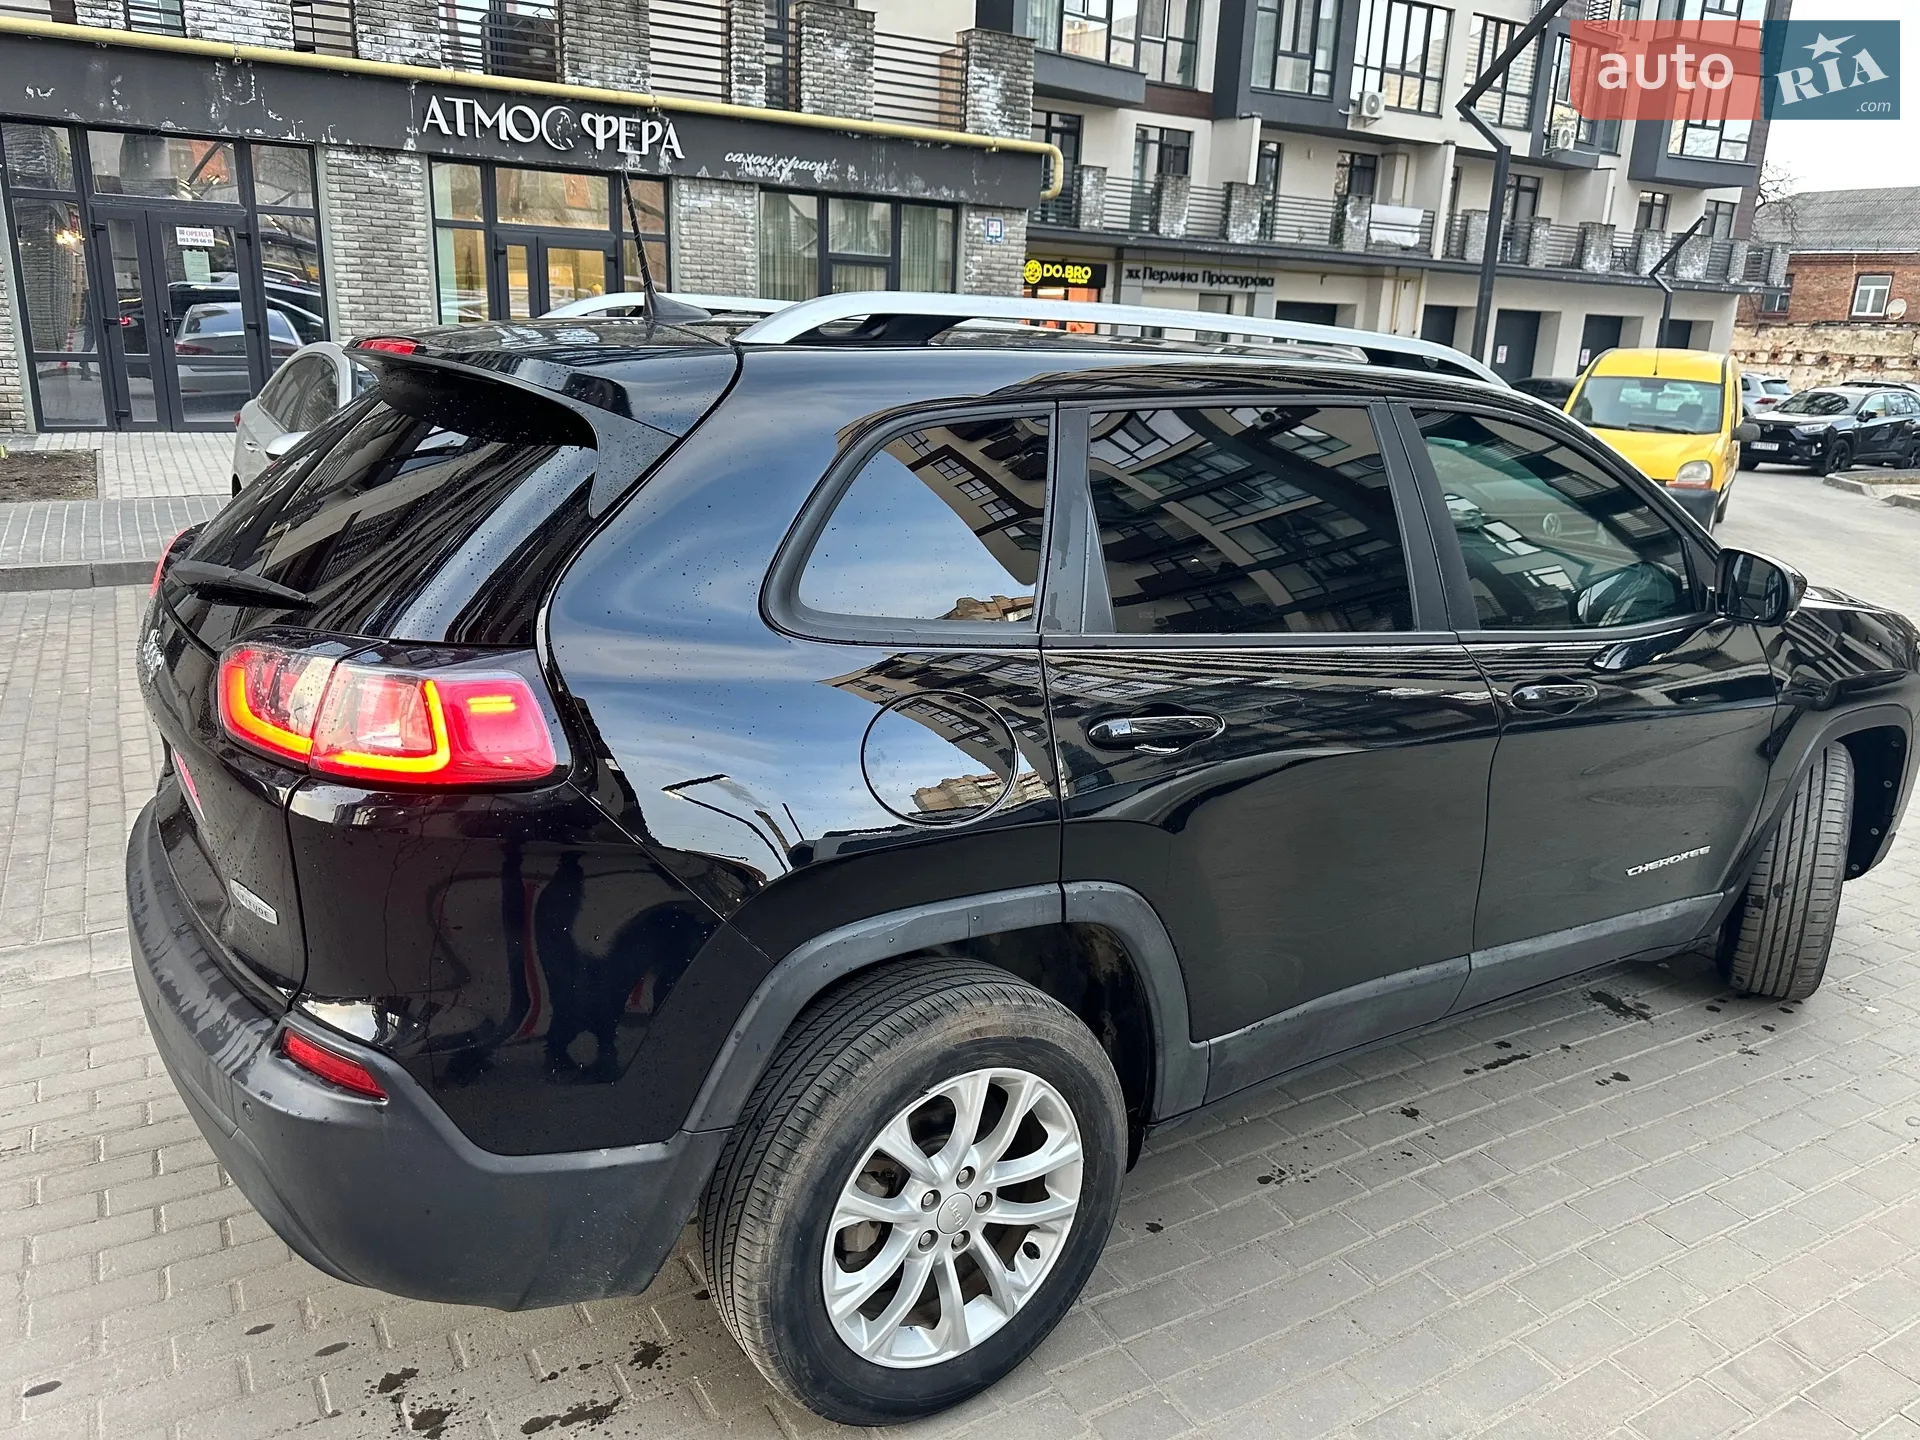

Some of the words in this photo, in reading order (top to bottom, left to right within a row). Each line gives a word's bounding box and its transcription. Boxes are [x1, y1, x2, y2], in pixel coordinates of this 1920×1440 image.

[422, 95, 687, 160] АТМОСФЕРА
[1043, 264, 1092, 279] DO.BRO
[1143, 266, 1199, 284] Перлина
[1202, 270, 1275, 288] Проскурова
[1626, 845, 1711, 877] CHEROKEE
[947, 1202, 963, 1225] Jeep
